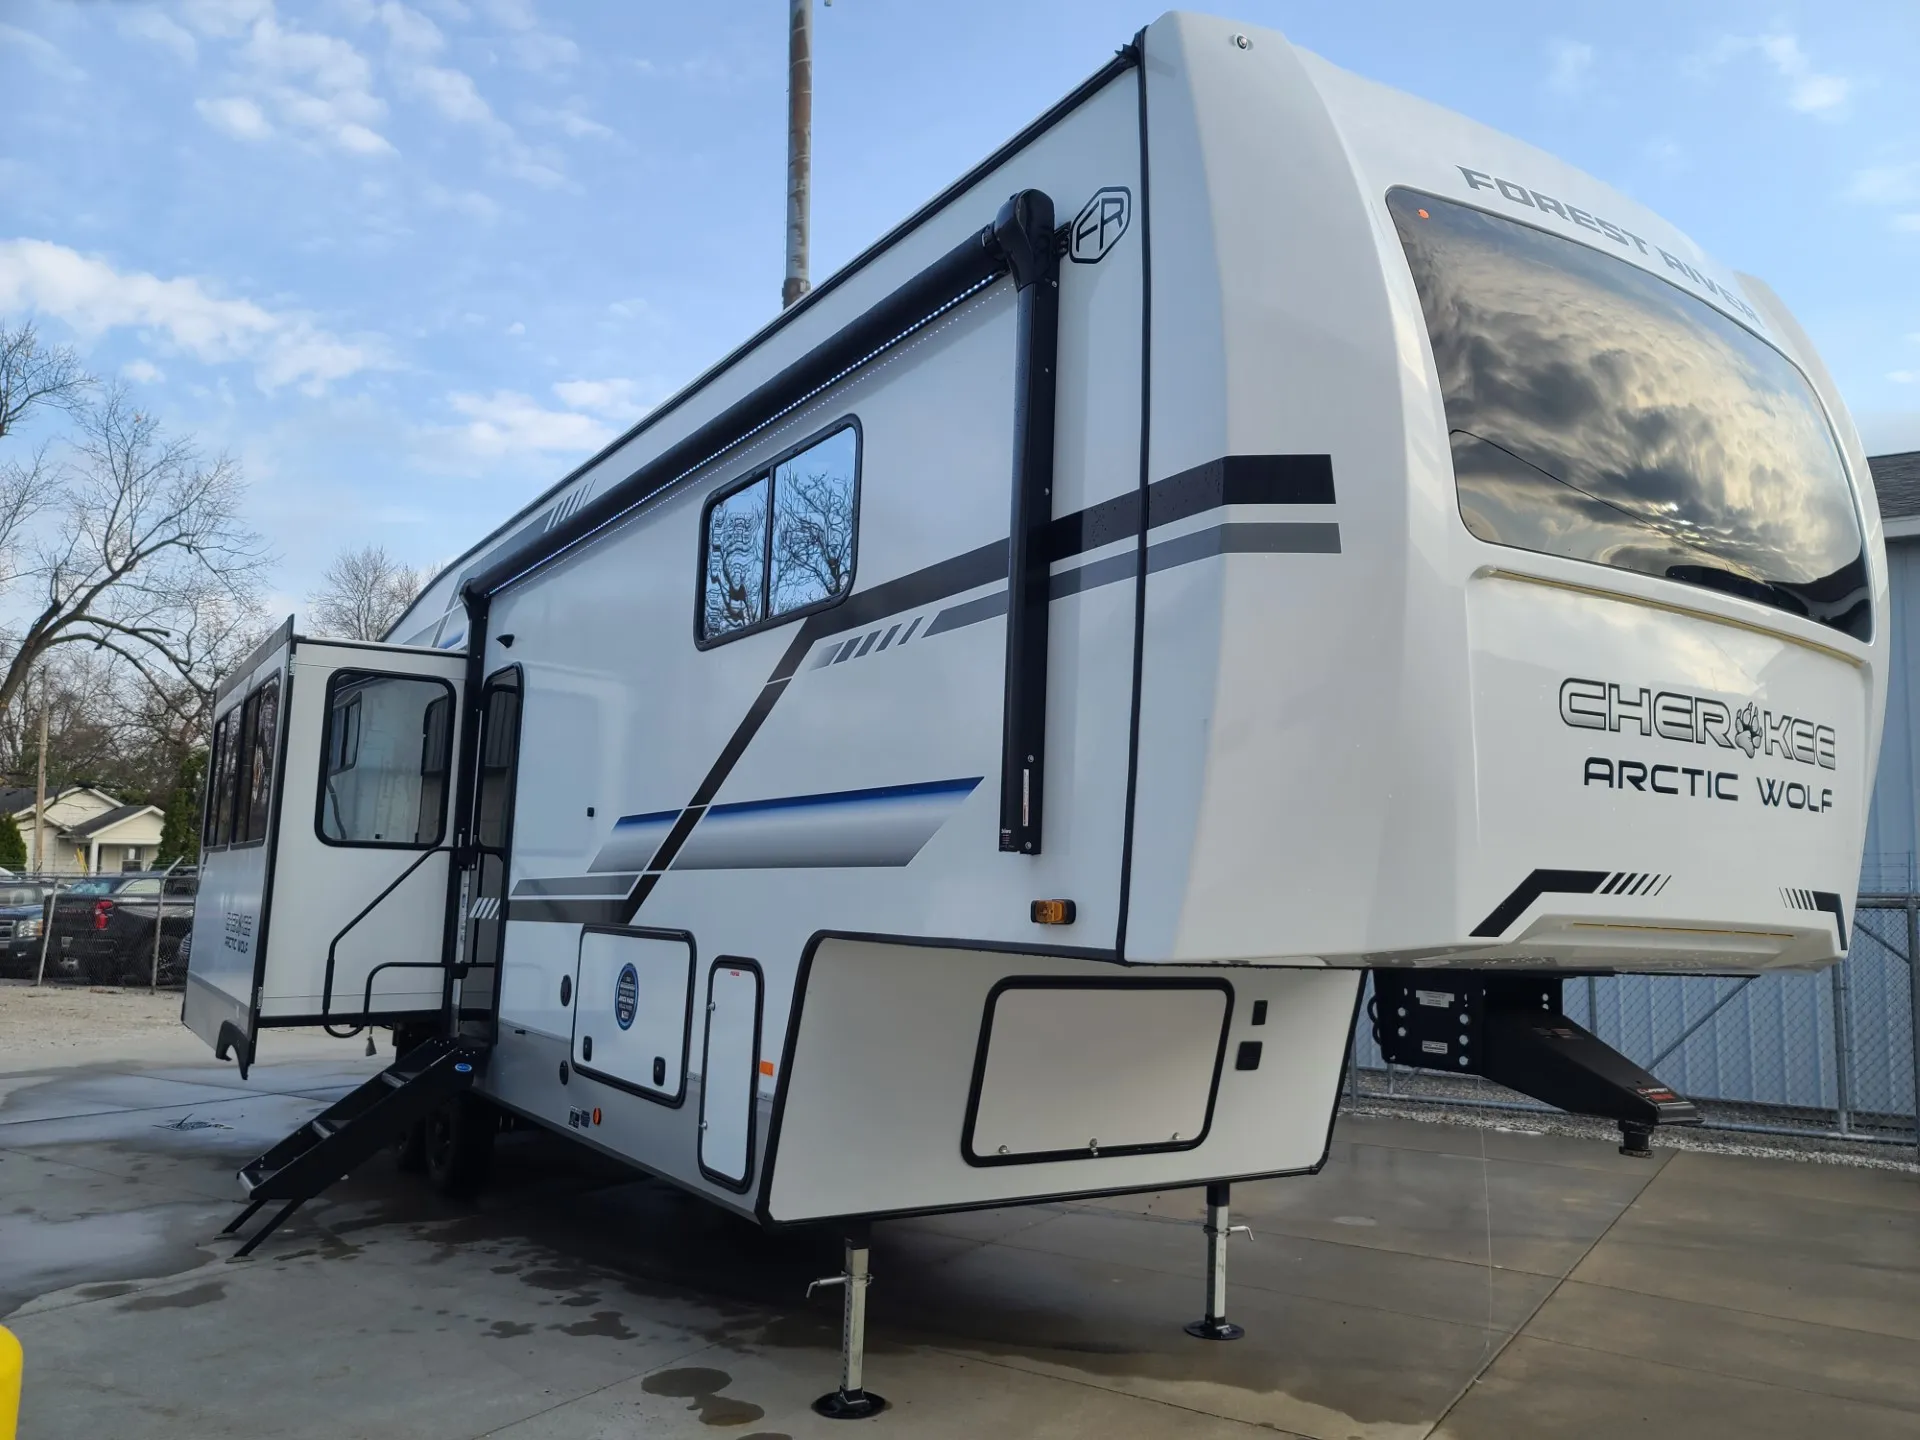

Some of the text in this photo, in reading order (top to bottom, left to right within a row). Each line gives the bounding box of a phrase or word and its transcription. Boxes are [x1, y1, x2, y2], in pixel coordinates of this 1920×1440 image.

[1455, 164, 1765, 330] FOREST RIVER
[1584, 756, 1833, 813] ARCTIC WOLF
